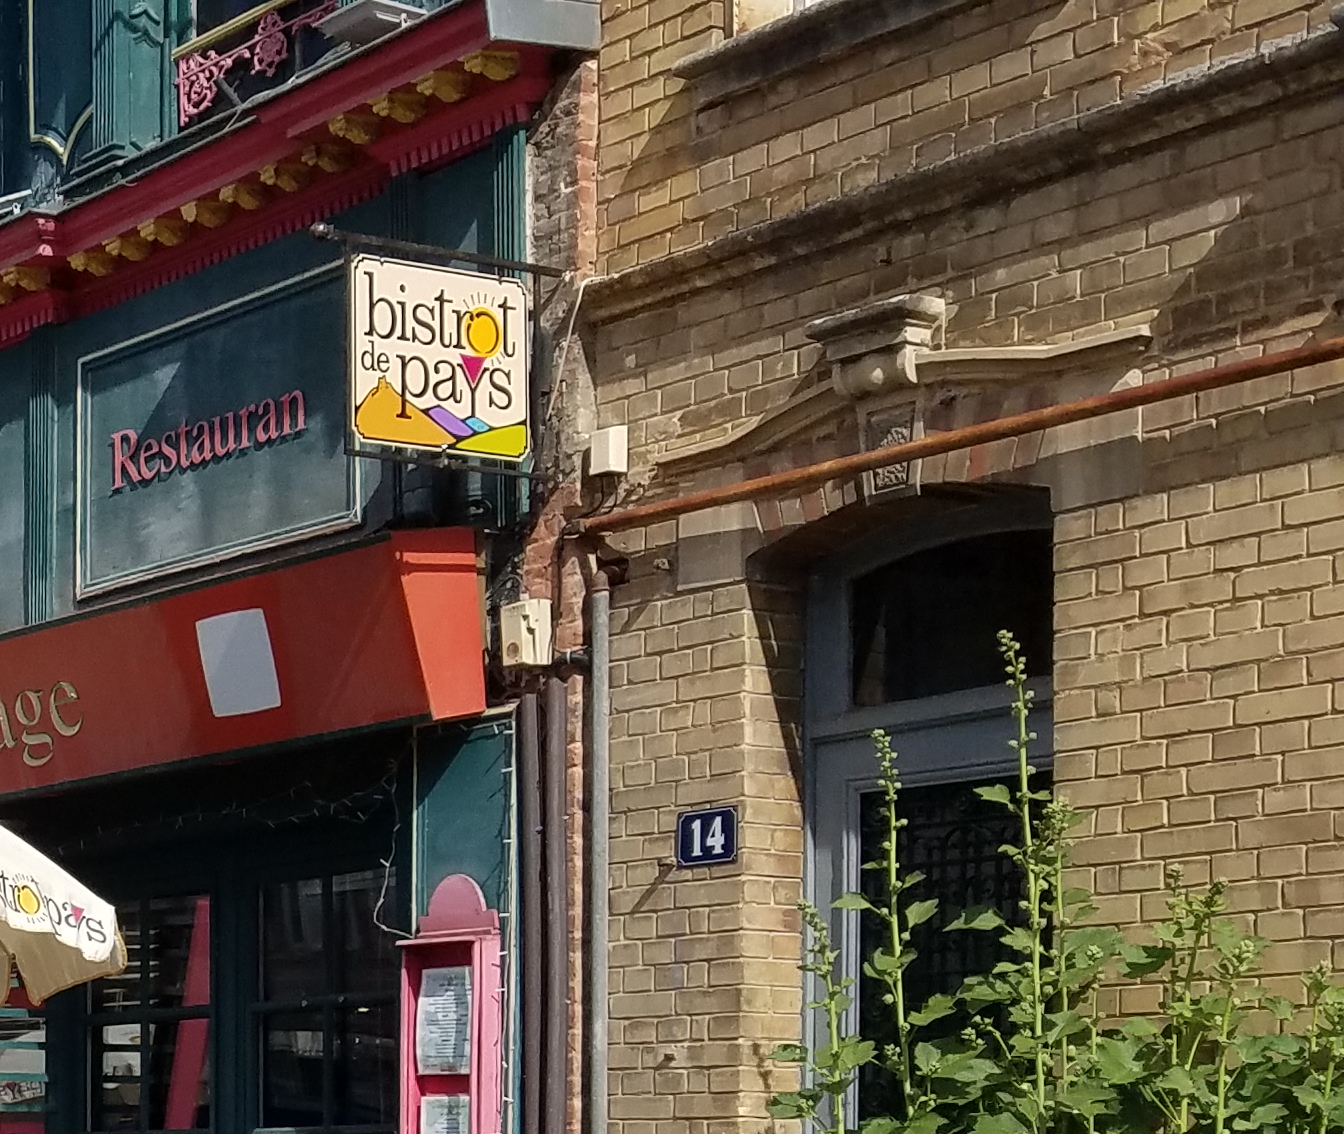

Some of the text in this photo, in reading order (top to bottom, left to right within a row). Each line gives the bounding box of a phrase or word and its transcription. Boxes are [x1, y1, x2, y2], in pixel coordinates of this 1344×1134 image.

[363, 271, 517, 358] bistrot
[362, 340, 513, 419] de pays
[689, 817, 725, 857] 14
